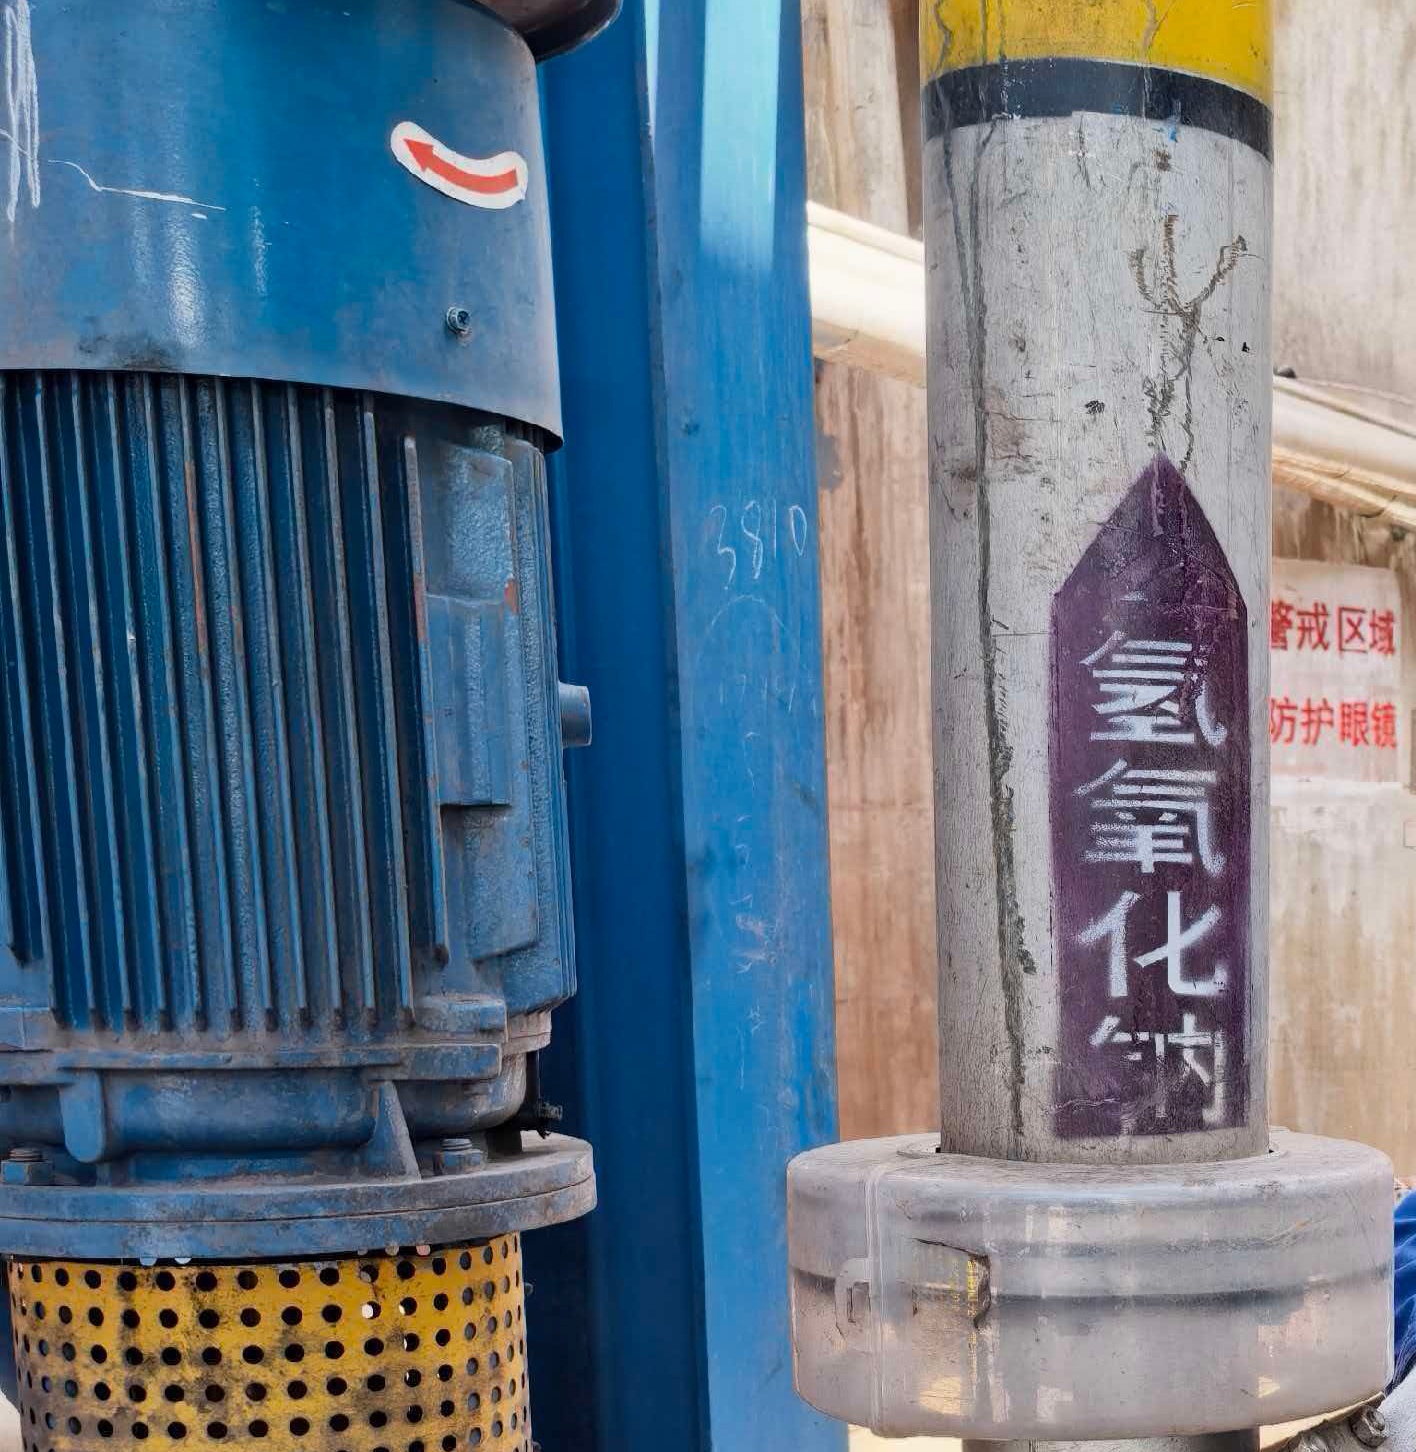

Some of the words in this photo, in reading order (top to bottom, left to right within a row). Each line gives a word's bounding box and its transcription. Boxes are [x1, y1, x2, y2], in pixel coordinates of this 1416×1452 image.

[1271, 598, 1396, 656] 警戒区域
[1271, 696, 1398, 748] 防护眼镜
[1073, 630, 1228, 1135] 氢氧化钠
